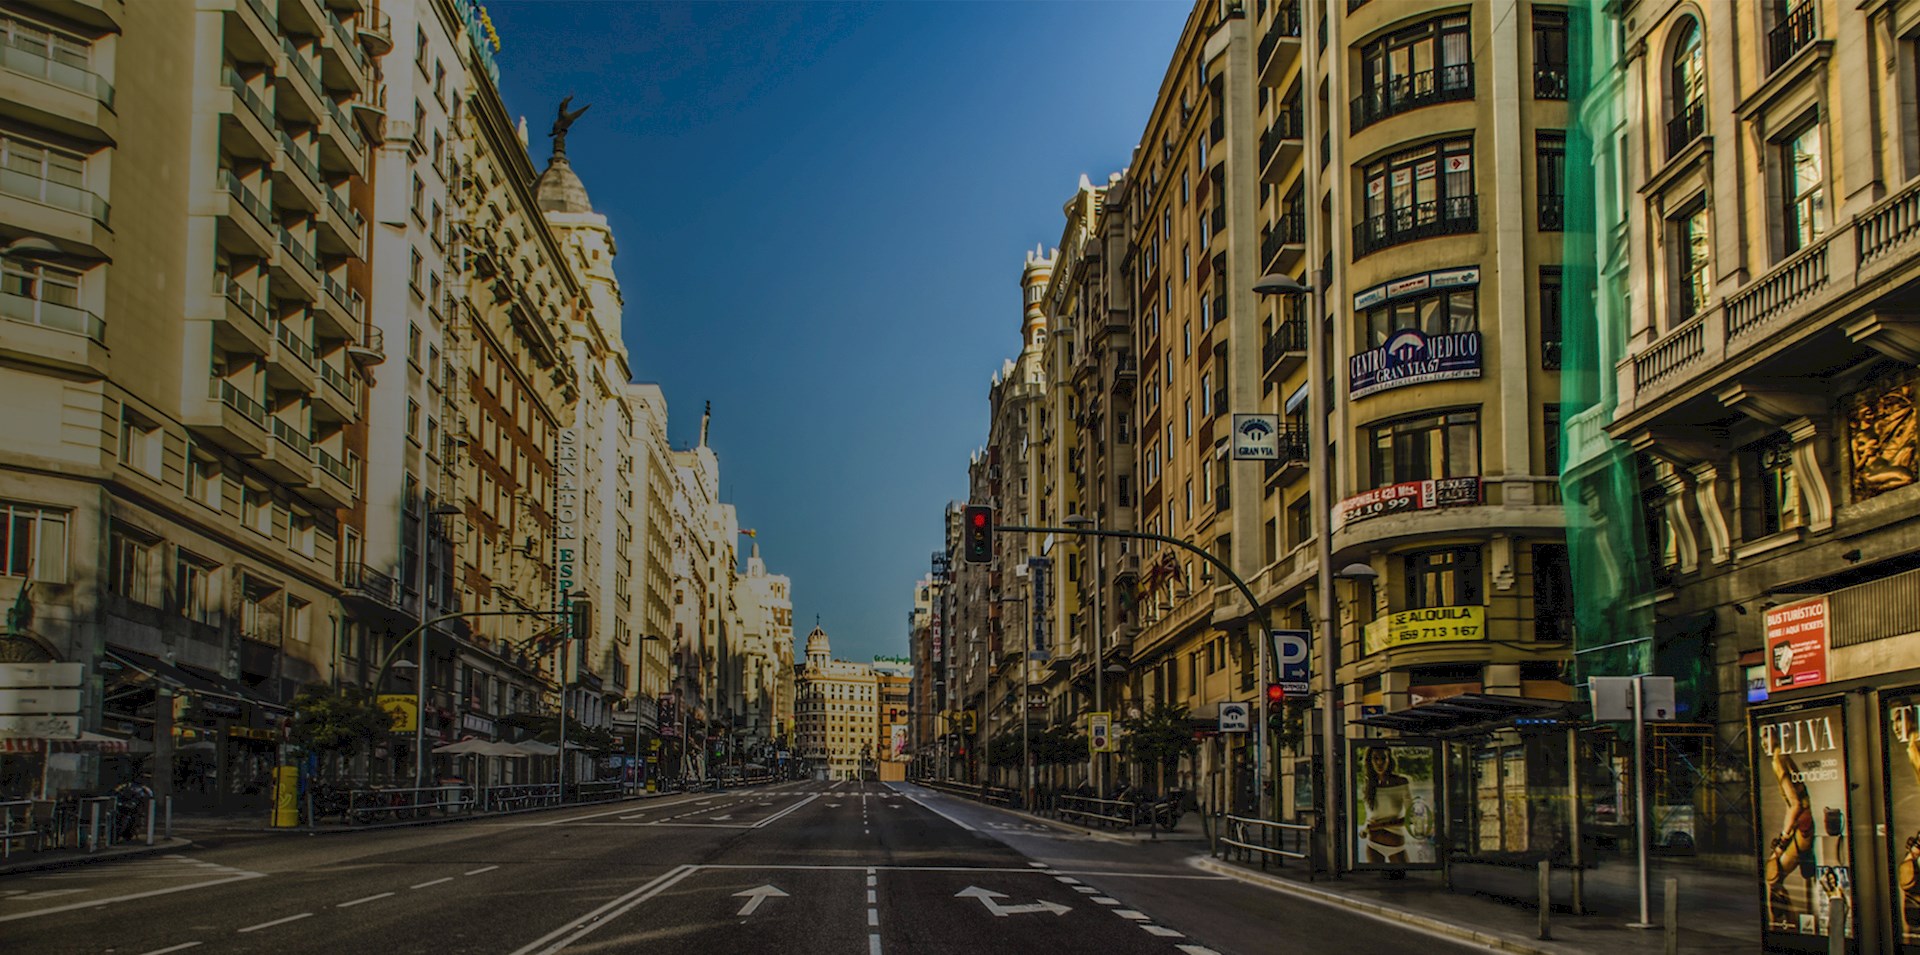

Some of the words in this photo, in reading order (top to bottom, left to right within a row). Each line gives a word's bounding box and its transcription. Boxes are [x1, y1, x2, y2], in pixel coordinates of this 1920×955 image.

[1351, 346, 1387, 379] CENTRO
[1426, 332, 1478, 360] MEDICO
[1376, 364, 1404, 383] GRAN
[1407, 359, 1427, 376] VIA
[1427, 358, 1440, 373] 67
[1239, 447, 1259, 456] GRAN
[1260, 447, 1273, 455] VIA
[558, 430, 577, 540] SENATOR
[1381, 487, 1396, 500] 420
[1366, 502, 1383, 515] 10
[1388, 496, 1410, 509] 99
[1395, 613, 1406, 625] SE
[1409, 608, 1472, 622] ALQUILA
[1767, 613, 1783, 627] BUS
[1782, 603, 1824, 622] TURÍSTICO
[1800, 619, 1824, 632] TICKETS
[1422, 627, 1447, 638] 713
[1452, 625, 1479, 636] 167
[1274, 635, 1308, 679] P
[1760, 716, 1836, 757] TELVA
